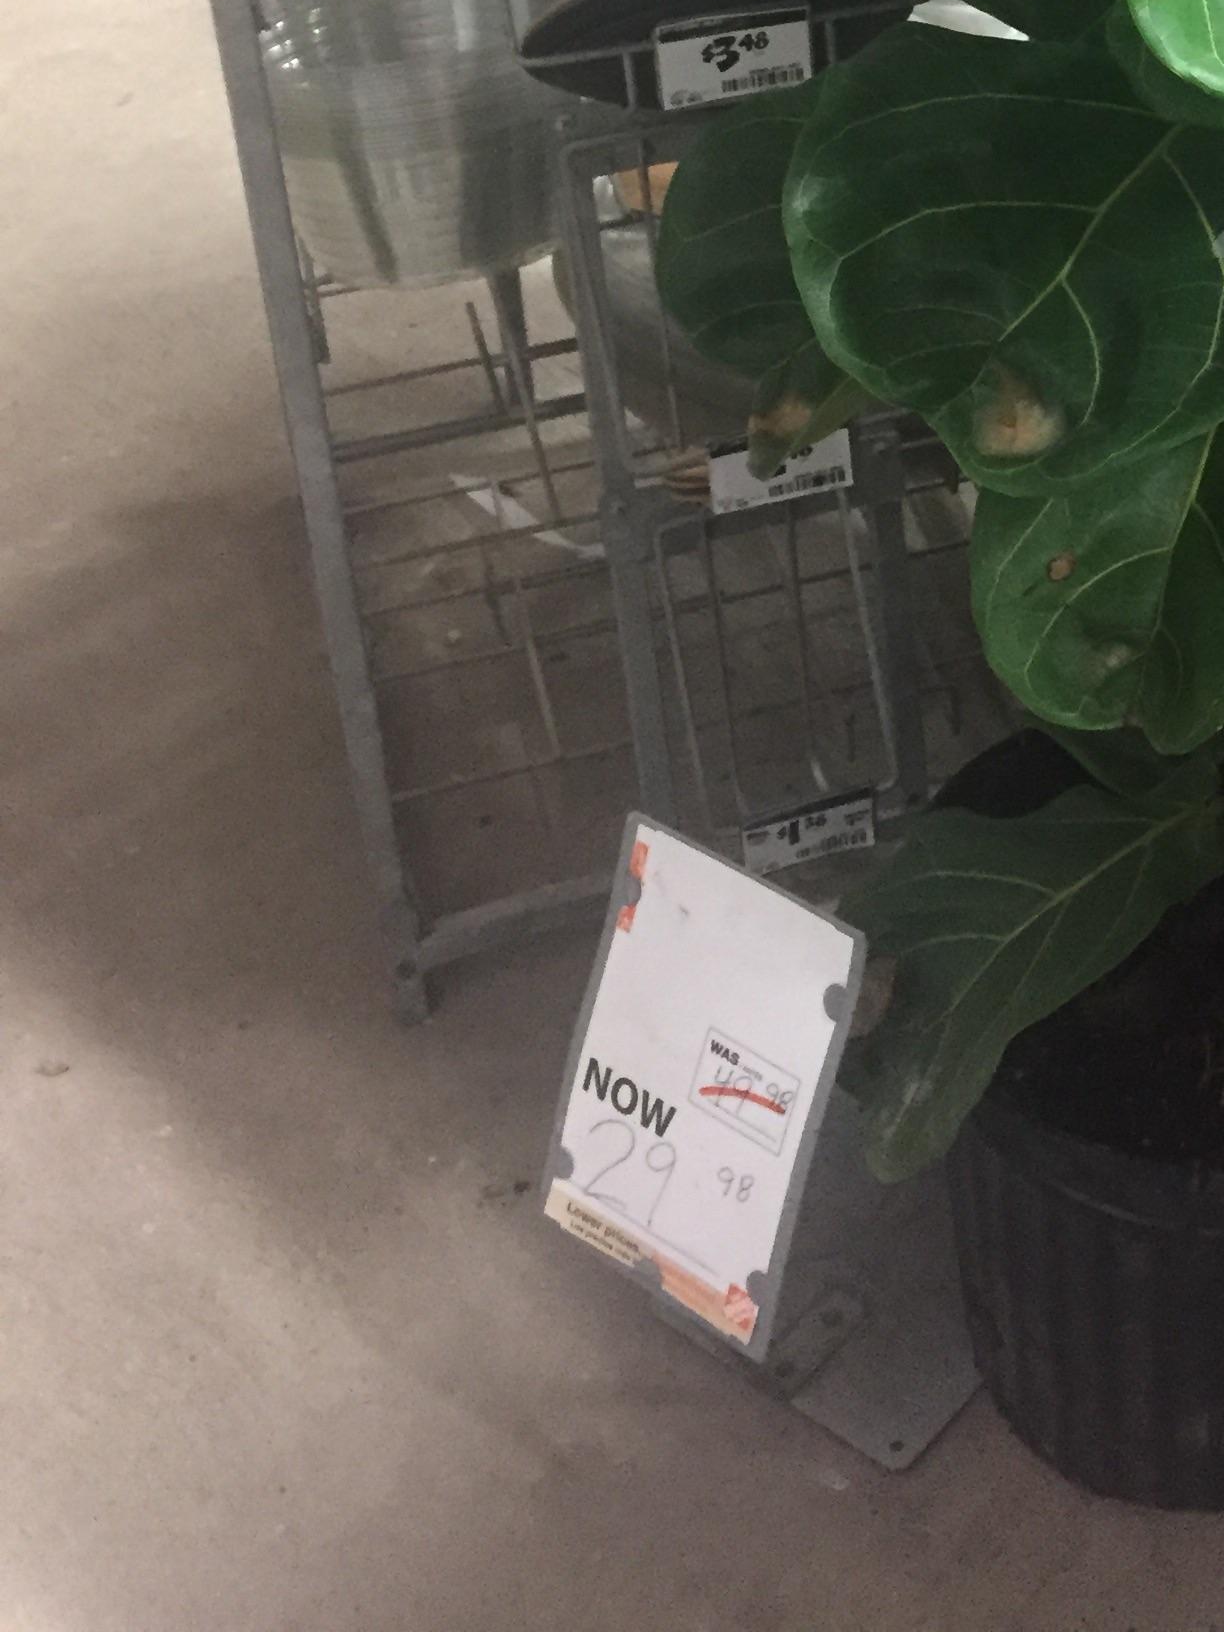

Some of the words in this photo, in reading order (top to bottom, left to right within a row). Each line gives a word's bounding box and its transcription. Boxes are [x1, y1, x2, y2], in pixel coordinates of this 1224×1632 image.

[710, 1039, 740, 1066] WAS
[583, 1057, 677, 1138] NOW
[584, 1118, 677, 1227] 29
[717, 1166, 756, 1204] 98
